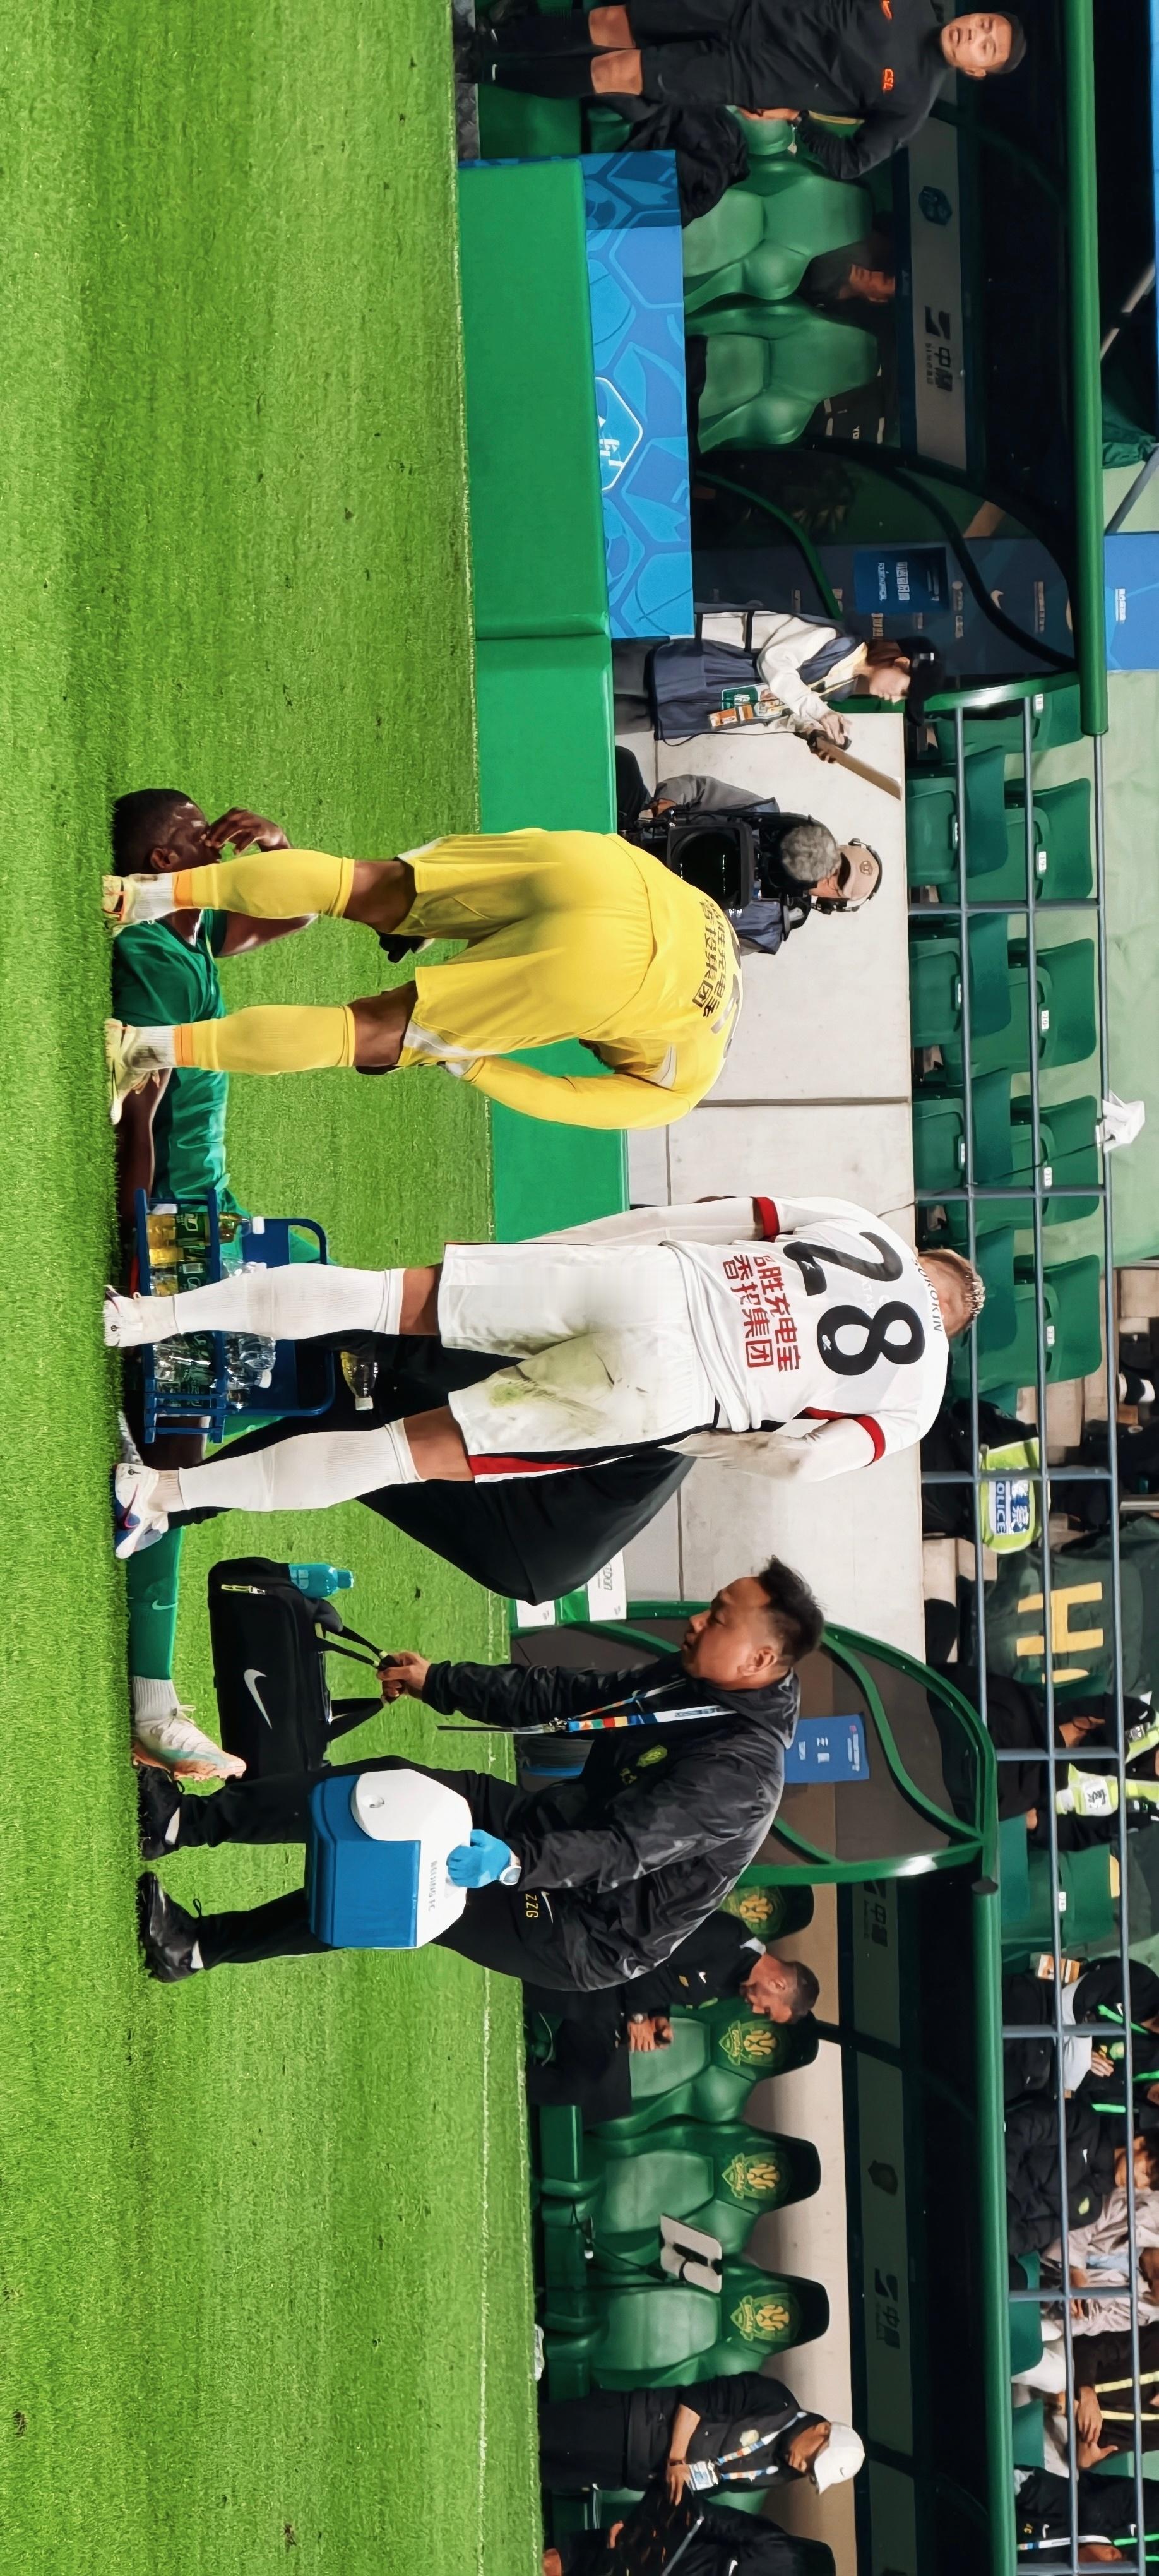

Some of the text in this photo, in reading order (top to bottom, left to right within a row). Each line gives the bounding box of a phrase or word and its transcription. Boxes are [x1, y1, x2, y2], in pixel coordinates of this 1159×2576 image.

[722, 1255, 774, 1368] 香投集团
[783, 1232, 925, 1376] 28
[912, 1260, 942, 1332] OROKIN
[996, 1482, 1006, 1534] OLICE
[525, 1893, 538, 1918] ZZG
